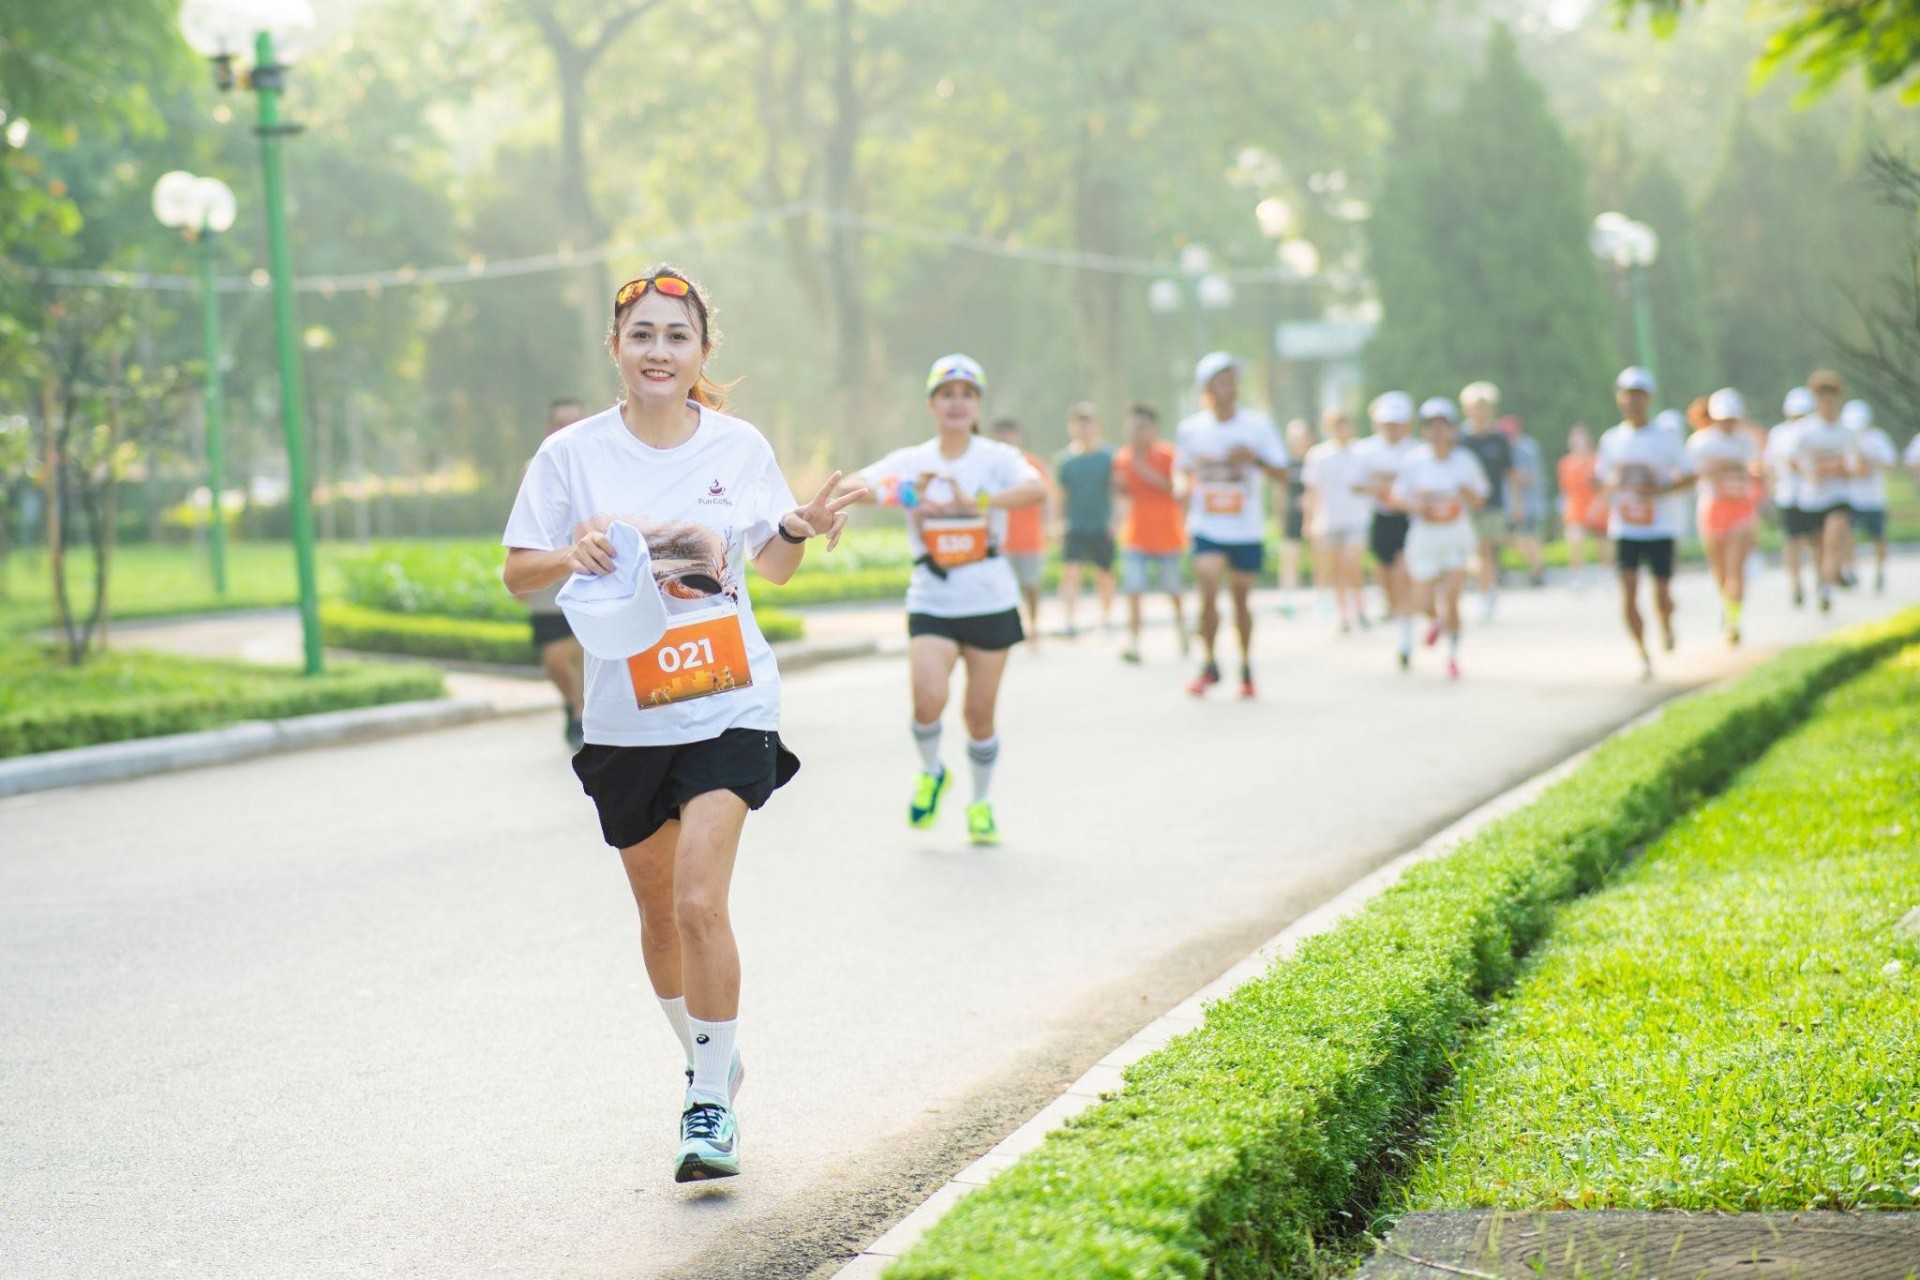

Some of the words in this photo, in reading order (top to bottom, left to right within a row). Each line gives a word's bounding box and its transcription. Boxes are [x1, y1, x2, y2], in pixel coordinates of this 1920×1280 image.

[698, 497, 713, 505] Fun
[713, 497, 733, 506] Coff
[657, 637, 715, 673] 021
